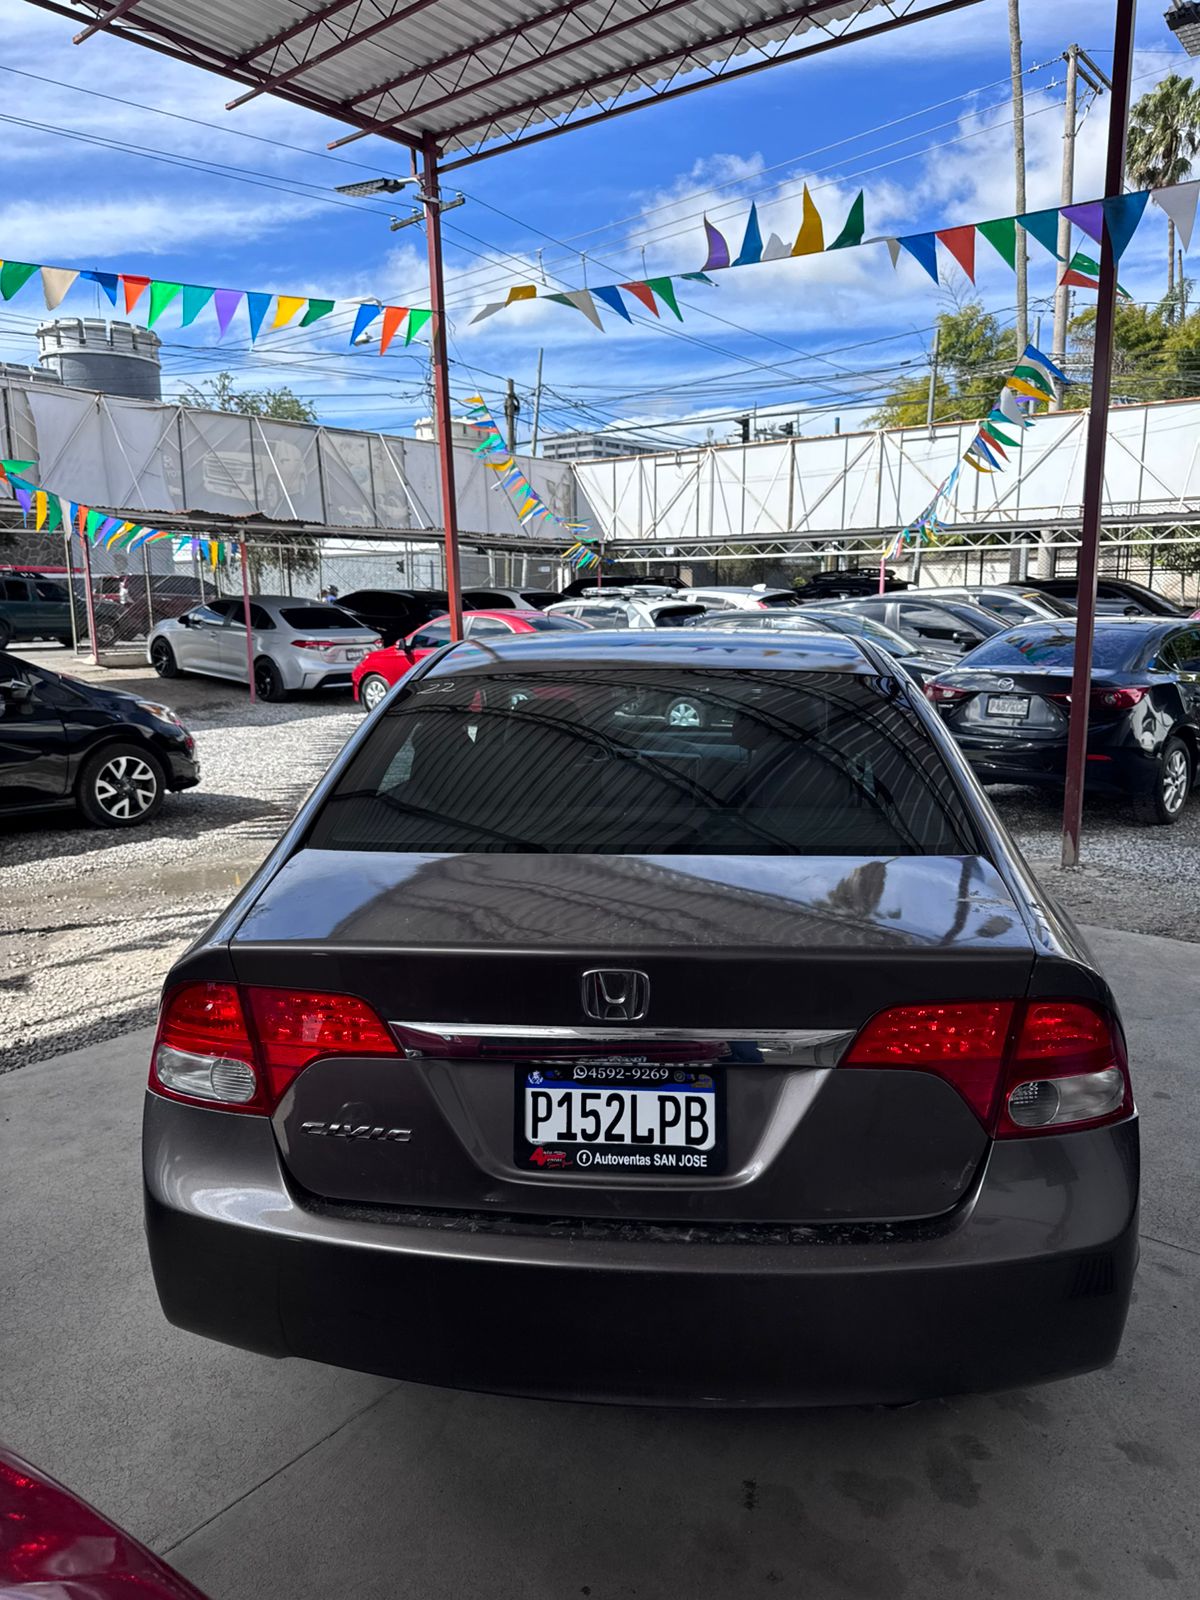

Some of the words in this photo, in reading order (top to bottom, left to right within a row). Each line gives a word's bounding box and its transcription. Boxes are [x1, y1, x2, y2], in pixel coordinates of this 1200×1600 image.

[588, 1067, 669, 1081] 4592-9269
[530, 1090, 709, 1146] P152LPB
[301, 1121, 412, 1142] CIVIC
[594, 1152, 651, 1167] Autoventas
[654, 1153, 677, 1167] SAN
[679, 1154, 708, 1168] JOSE
